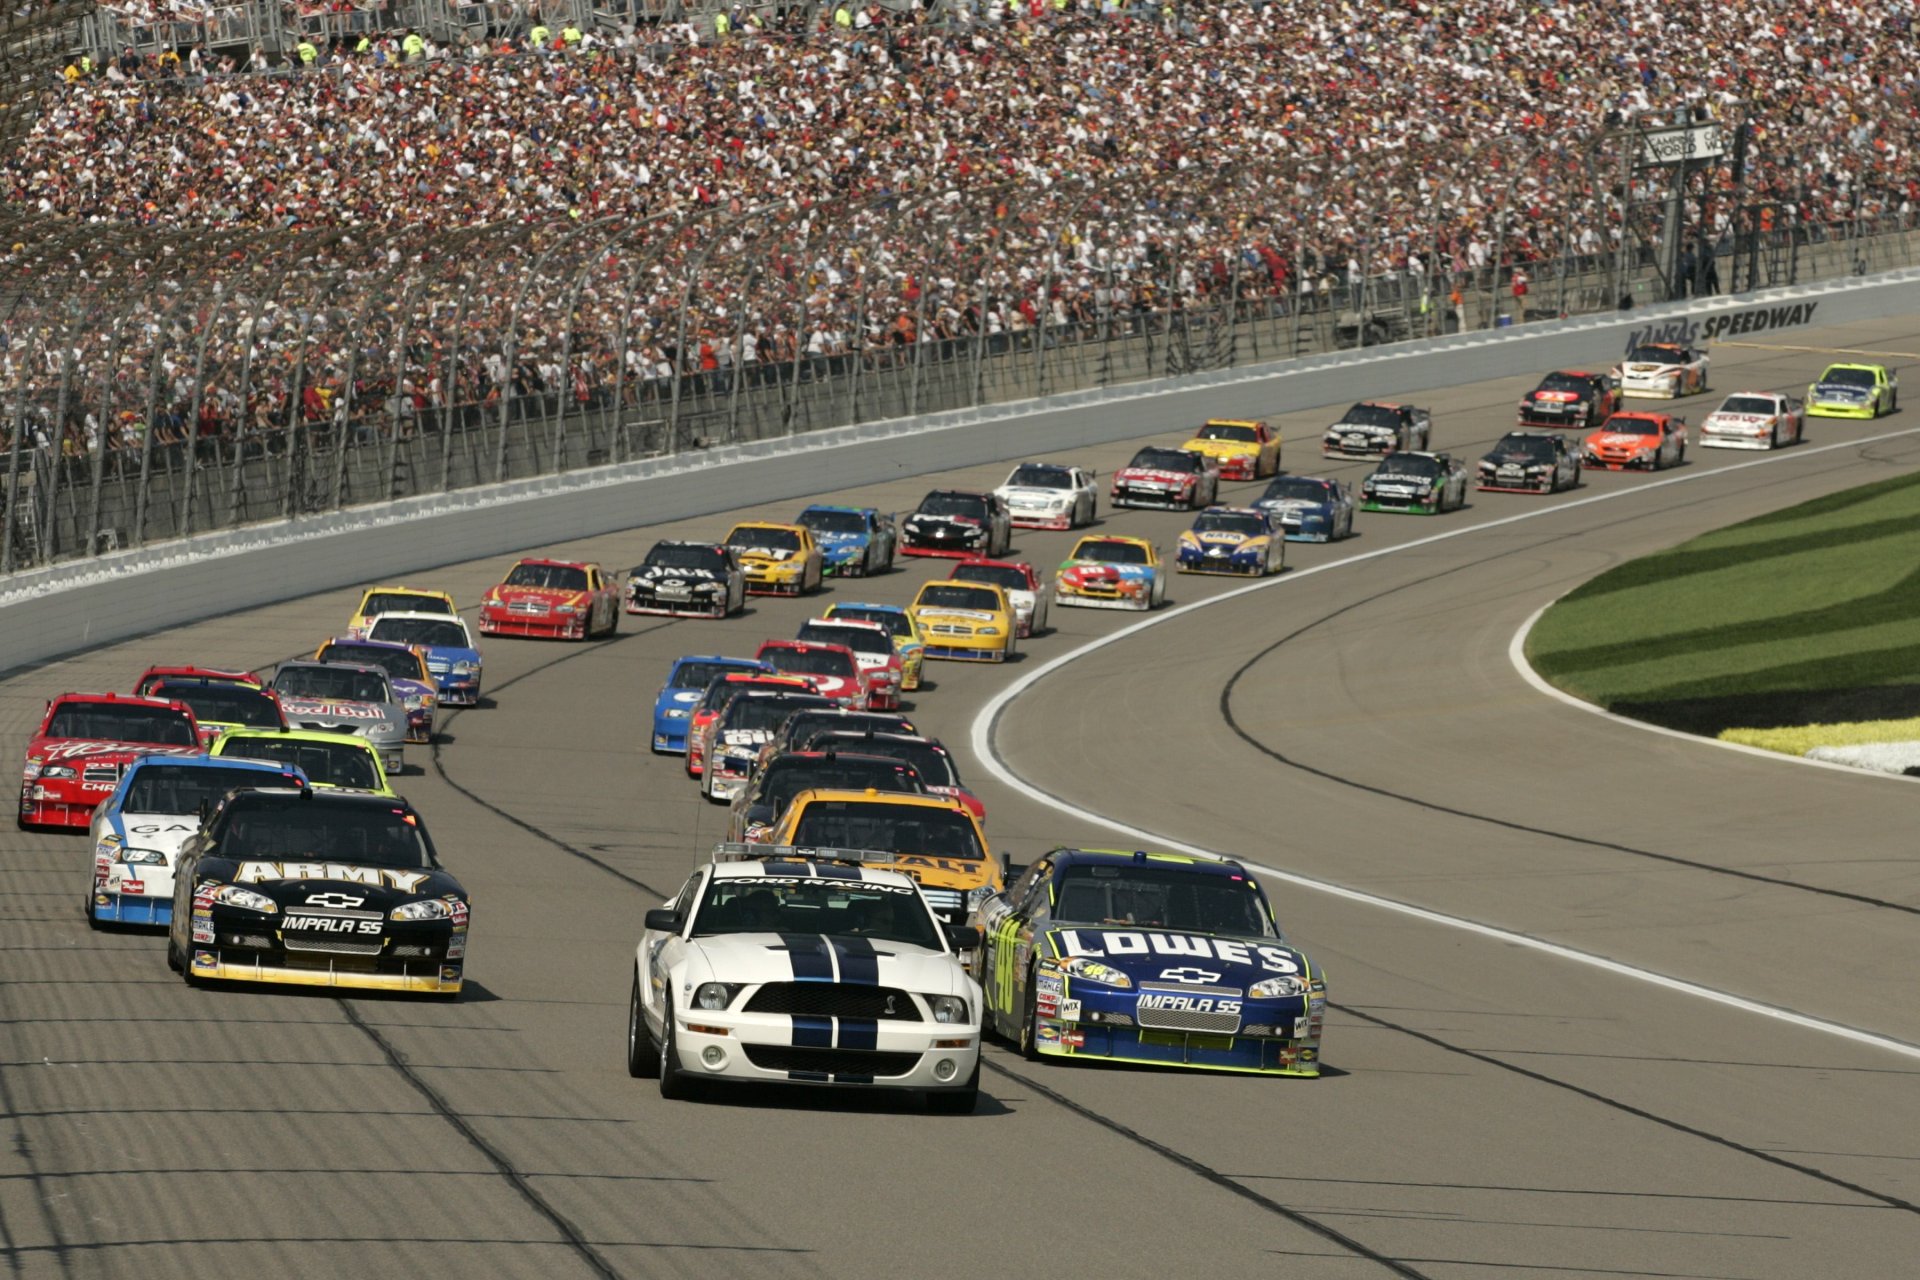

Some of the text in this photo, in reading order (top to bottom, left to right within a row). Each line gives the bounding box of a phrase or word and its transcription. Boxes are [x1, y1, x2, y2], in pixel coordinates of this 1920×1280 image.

[1625, 302, 1818, 354] KANSAS SPEEDWAY
[1205, 531, 1241, 541] NAPA
[644, 565, 715, 579] JACK
[332, 705, 386, 719] Bull
[128, 850, 150, 863] 19
[233, 861, 431, 894] ARMY
[714, 877, 914, 895] FORD RACING
[281, 916, 384, 935] IMPALA SS
[1061, 930, 1299, 973] LOWE'S
[1062, 1001, 1079, 1012] WIX
[1137, 994, 1242, 1015] IMPALA SS
